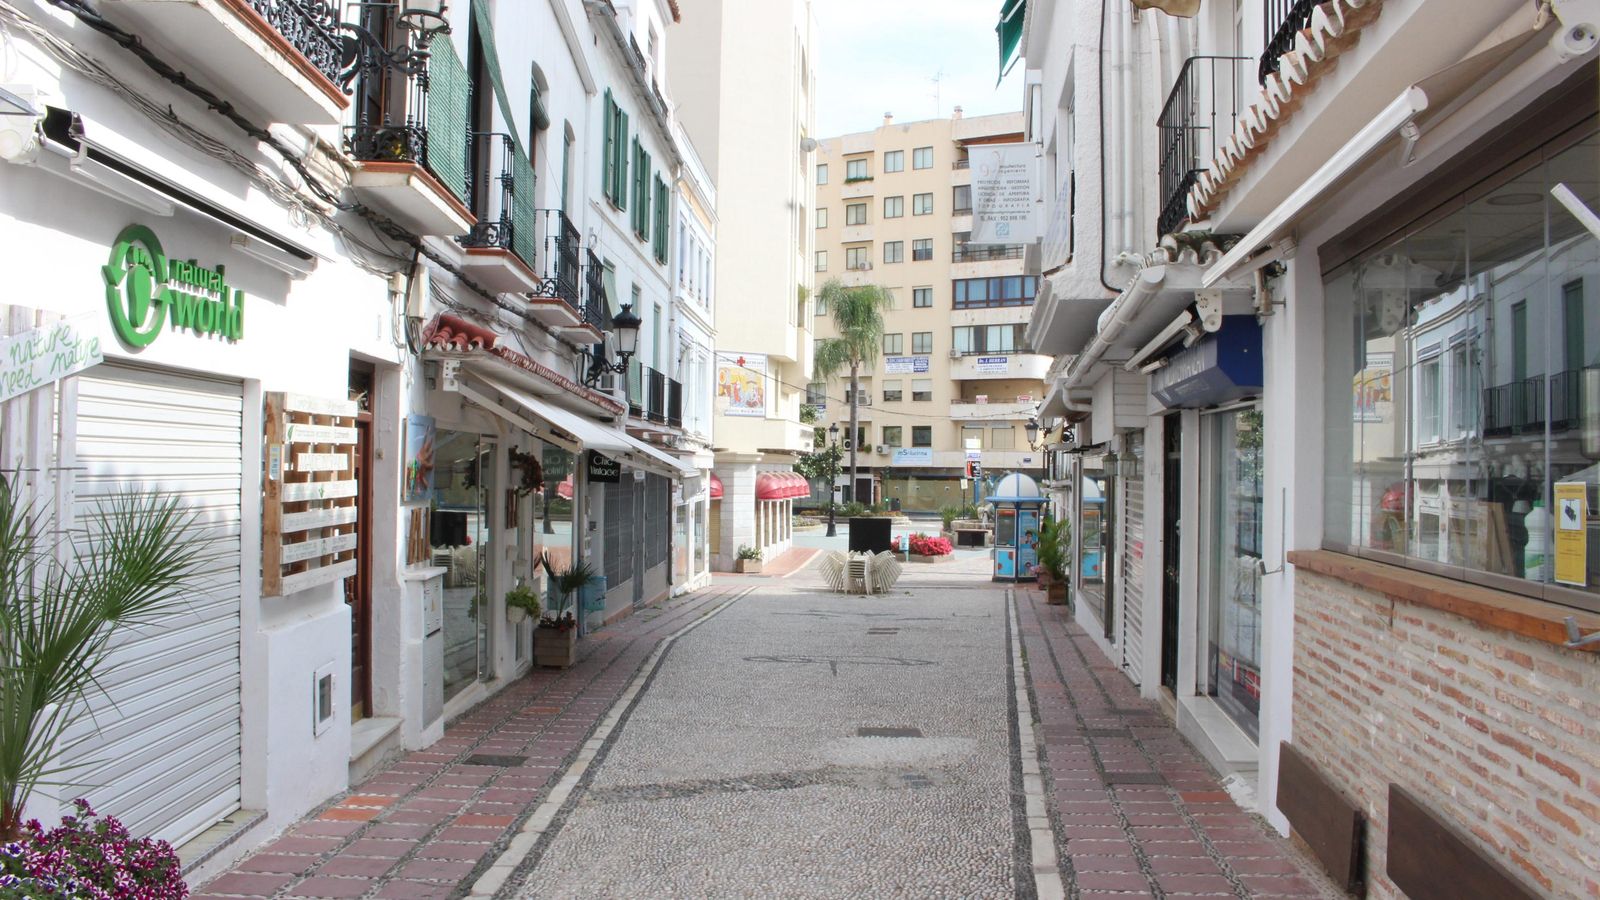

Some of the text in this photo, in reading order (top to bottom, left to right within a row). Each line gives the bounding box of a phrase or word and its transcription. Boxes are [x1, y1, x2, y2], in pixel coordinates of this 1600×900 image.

[169, 259, 225, 294] natural
[169, 286, 245, 340] world
[590, 465, 619, 476] Vintage
